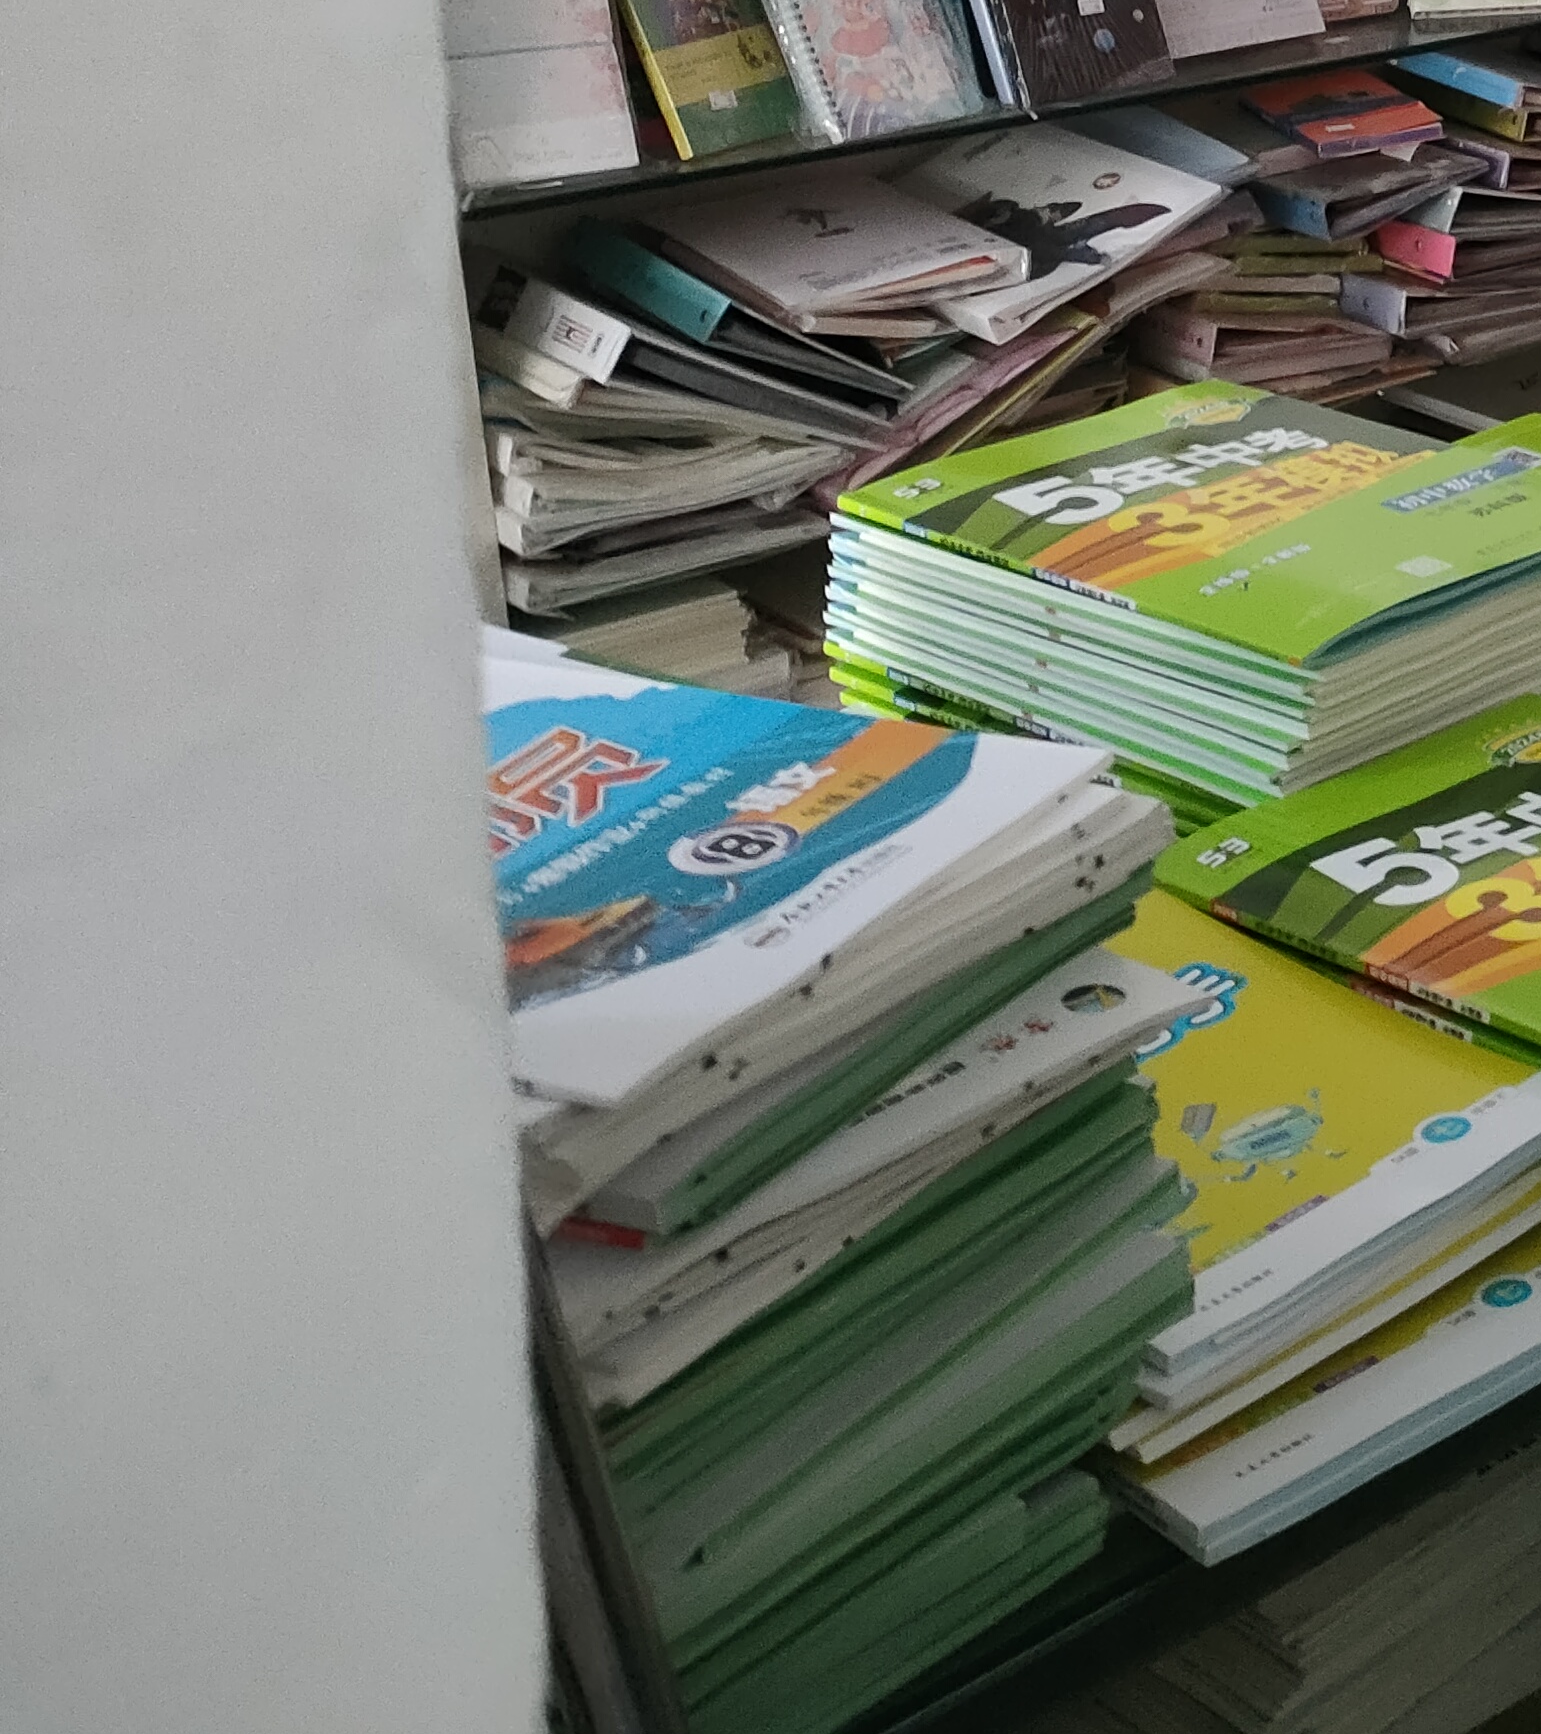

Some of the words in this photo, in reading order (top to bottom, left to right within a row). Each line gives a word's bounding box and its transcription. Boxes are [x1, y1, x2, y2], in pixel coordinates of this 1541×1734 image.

[992, 425, 1330, 525] 5年中考
[1107, 439, 1400, 549] 3年模拟
[726, 761, 837, 814] 语文
[1195, 836, 1251, 868] 53
